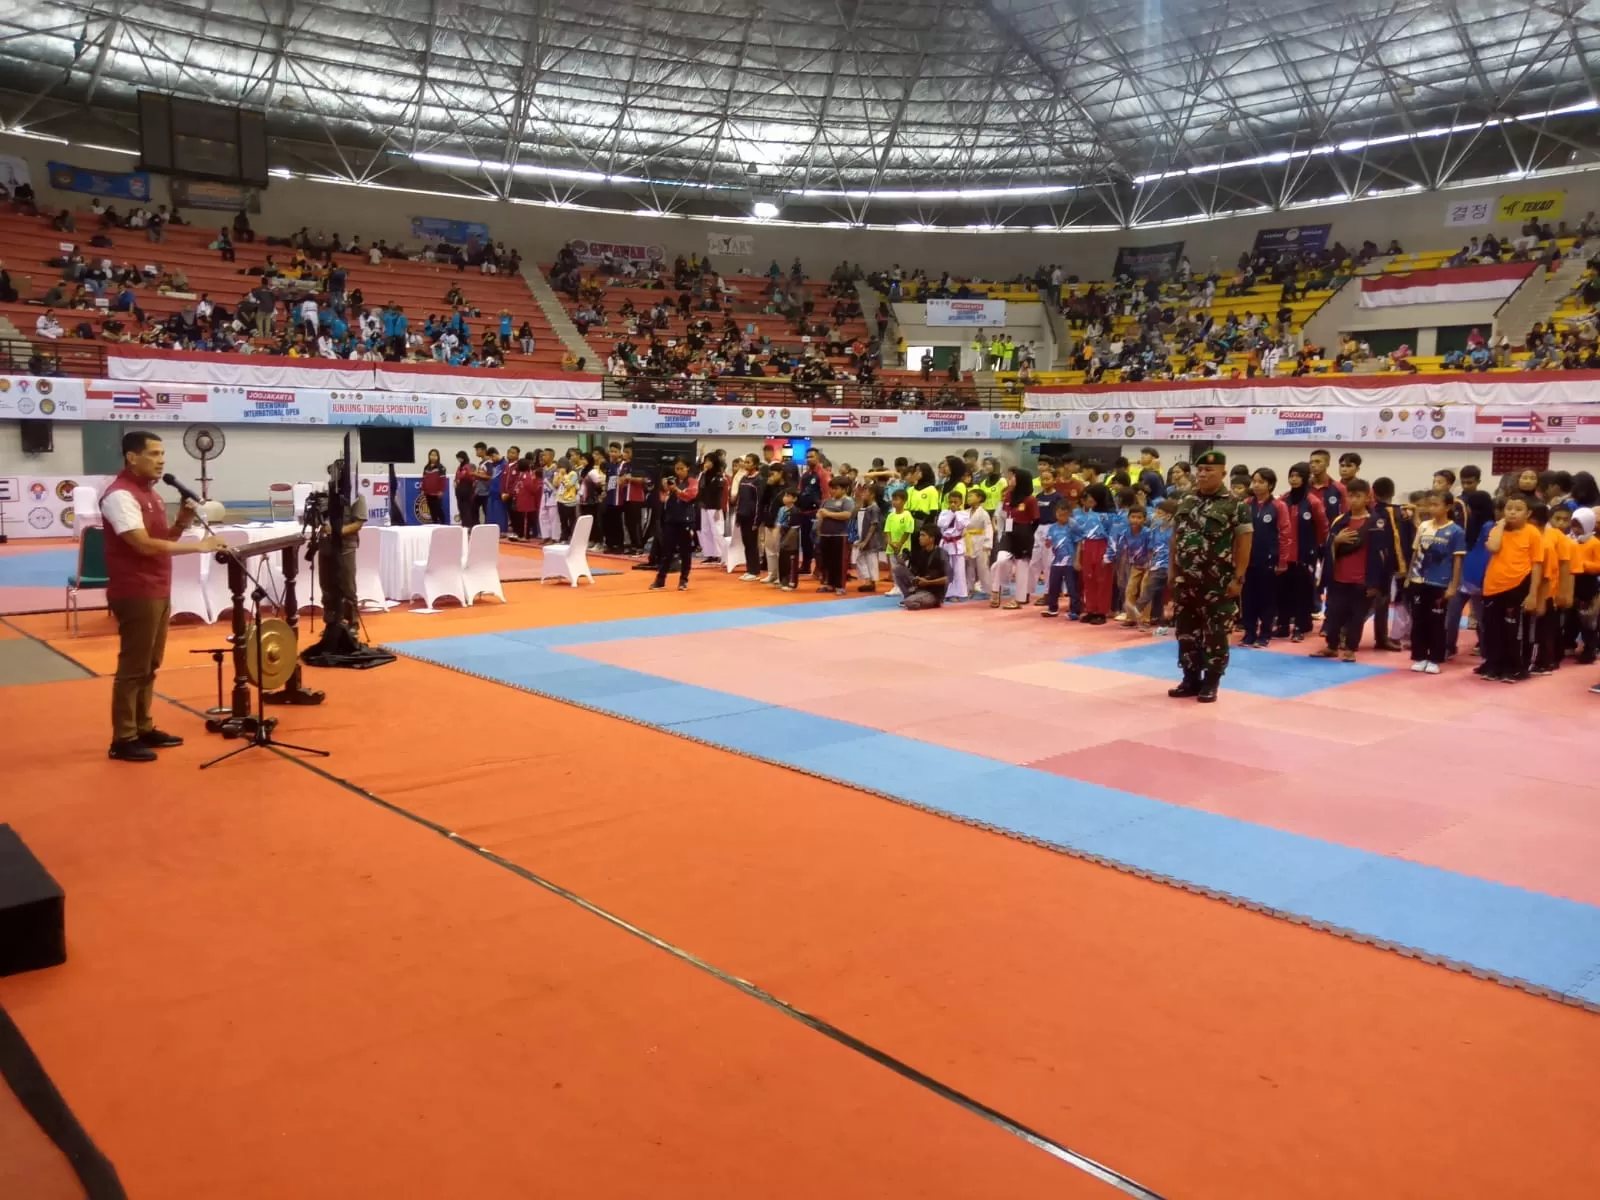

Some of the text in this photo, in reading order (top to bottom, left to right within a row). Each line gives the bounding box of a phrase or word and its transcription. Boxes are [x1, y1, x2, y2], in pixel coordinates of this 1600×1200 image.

[248, 391, 294, 400] JOGJAKARTA
[243, 408, 300, 418] INTERNATIONAL OPEN
[332, 403, 428, 415] JUNJUNG TINGGI SPORTIVITAS
